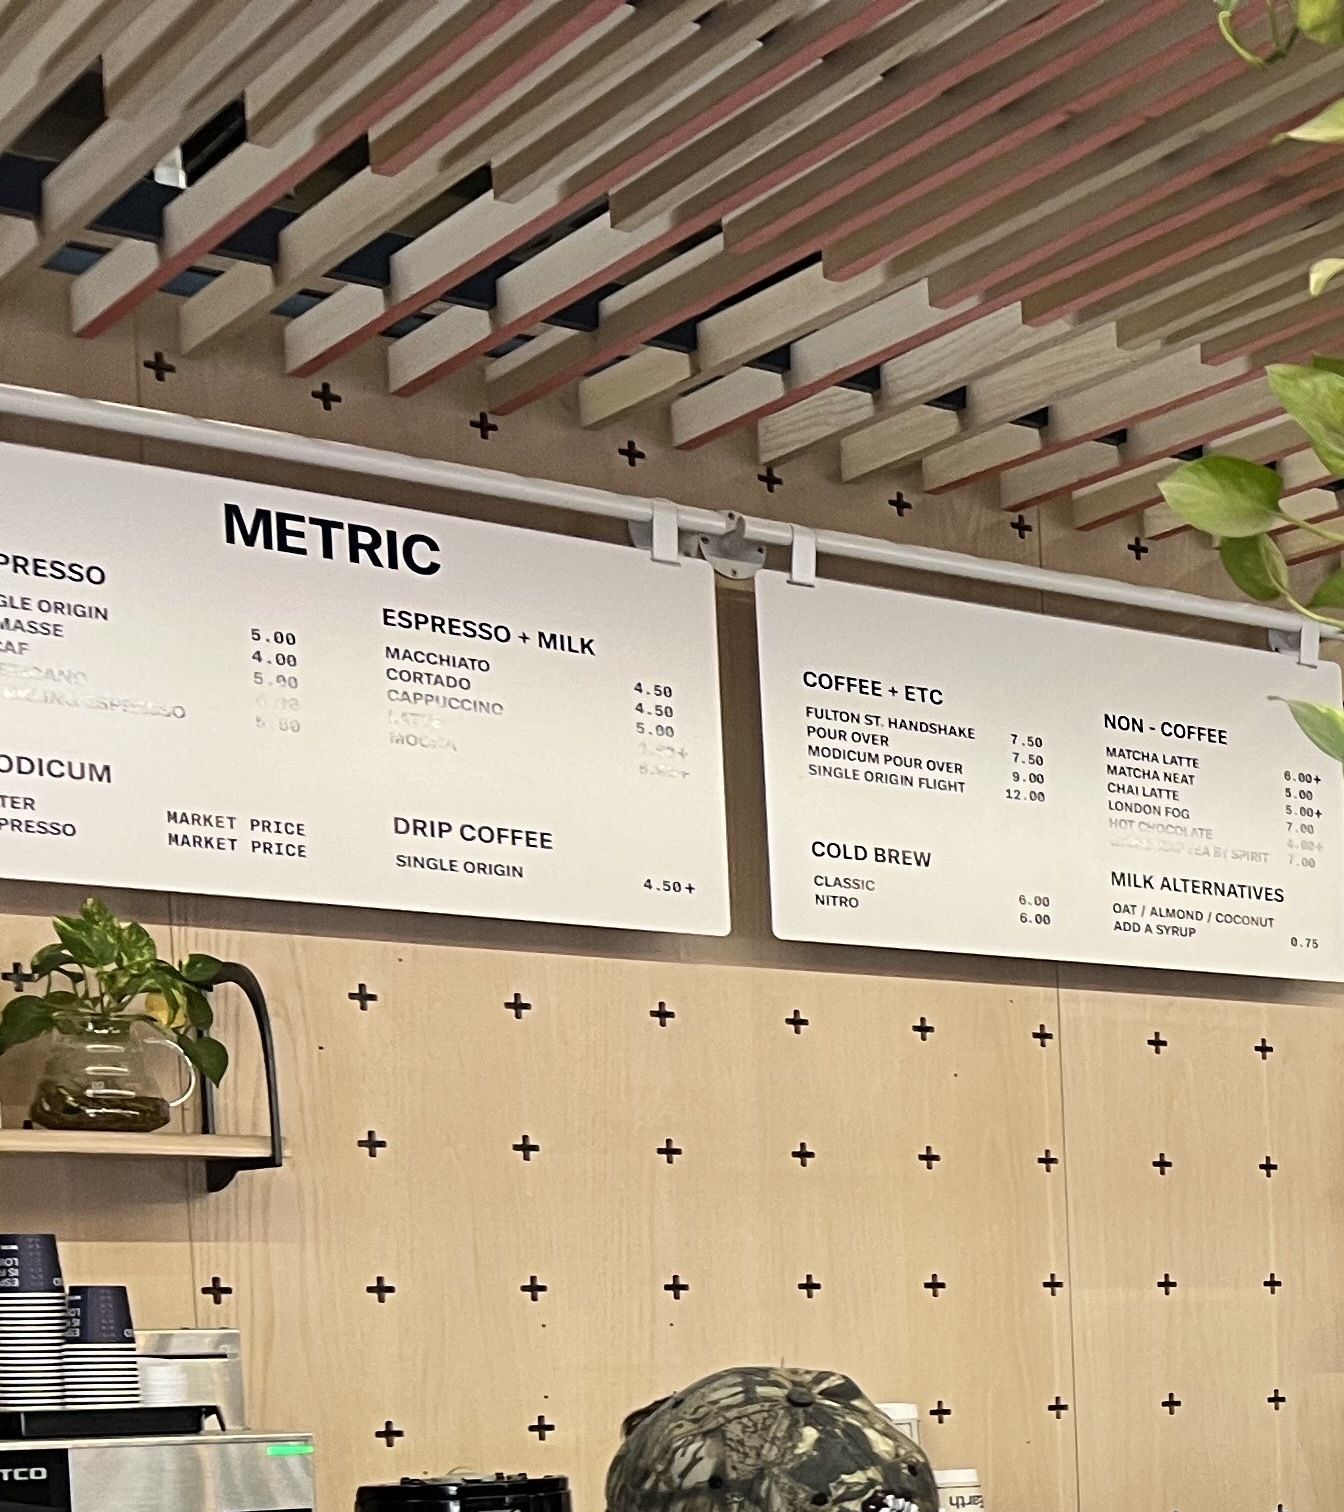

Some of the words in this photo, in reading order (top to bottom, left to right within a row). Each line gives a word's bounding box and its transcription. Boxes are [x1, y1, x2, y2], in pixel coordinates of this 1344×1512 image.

[223, 502, 442, 576] METRIC
[37, 599, 109, 621] ORIGIN
[251, 628, 296, 645] 5.00
[382, 608, 511, 644] ESPRESSO
[518, 630, 531, 645] +
[538, 631, 596, 656] MILK
[0, 639, 30, 656] AF
[252, 650, 297, 667] 4.00
[385, 646, 490, 672] MACCHIATO
[634, 682, 673, 698] 4.50
[803, 671, 882, 697] COFFEE
[888, 686, 899, 697] +
[904, 685, 943, 705] ETC
[386, 667, 471, 691] CORTADO
[635, 702, 674, 718] 4.50
[387, 689, 504, 716] CAPPUCCINO
[636, 722, 675, 738] 5.00
[805, 706, 860, 725] FULTON
[864, 714, 884, 728] ST.
[888, 717, 976, 740] HANDSHAKE
[1010, 734, 1042, 748] 7.50
[1103, 713, 1144, 733] NON
[1161, 721, 1228, 745] COFFEE
[807, 726, 847, 742] POUR
[851, 730, 889, 747] OVER
[1012, 752, 1044, 766] 7.50
[807, 745, 880, 764] MODICUM
[884, 754, 923, 770] POUR
[926, 759, 963, 775] OVER
[1012, 771, 1045, 785] 9.00
[1106, 746, 1160, 763] MATCHA
[1162, 754, 1200, 769] LATTE
[1283, 770, 1322, 785] 6.00+
[808, 764, 860, 782] SINGLE
[864, 770, 914, 787] ORIGIN
[918, 777, 966, 793] FLIGHT
[1005, 788, 1045, 802] 12.00
[1107, 764, 1160, 781] MATCHA
[1163, 771, 1195, 785] NEAT
[1284, 787, 1313, 801] 5.00
[1107, 782, 1140, 796] CHAI
[1142, 787, 1180, 801] LATTE
[1285, 805, 1323, 819] 5.00+
[1108, 800, 1162, 817] LONDON
[1165, 806, 1190, 820] FOG
[1286, 822, 1314, 835] 7.00
[167, 810, 237, 831] MARKET
[250, 818, 306, 837] PRICE
[393, 816, 453, 840] DRIP
[459, 823, 554, 850] COFFEE
[1109, 817, 1136, 831] HOT
[1138, 821, 1213, 840] CHOCOLATE
[168, 832, 237, 852] MARKET
[251, 840, 307, 859] PRICE
[811, 841, 868, 861] COLD
[874, 847, 932, 868] BREW
[396, 854, 459, 873] SINGLE
[463, 860, 524, 878] ORIGIN
[643, 878, 696, 895] 4.50+
[813, 875, 876, 892] CLASSIC
[1018, 894, 1050, 907] 6.00
[1111, 871, 1155, 890] MILK
[1160, 876, 1285, 903] ALTERNATIVES
[815, 894, 859, 909] NITRO
[1020, 912, 1051, 925] 6.00
[1112, 902, 1137, 917] OAT
[1150, 906, 1204, 922] ALMOND
[1215, 912, 1275, 928] COCONUT
[1113, 920, 1141, 934] ADD
[1144, 923, 1153, 934] A
[1155, 924, 1197, 938] SYRUP
[1290, 936, 1319, 949] 0.75
[0, 1468, 47, 1480] TCO
